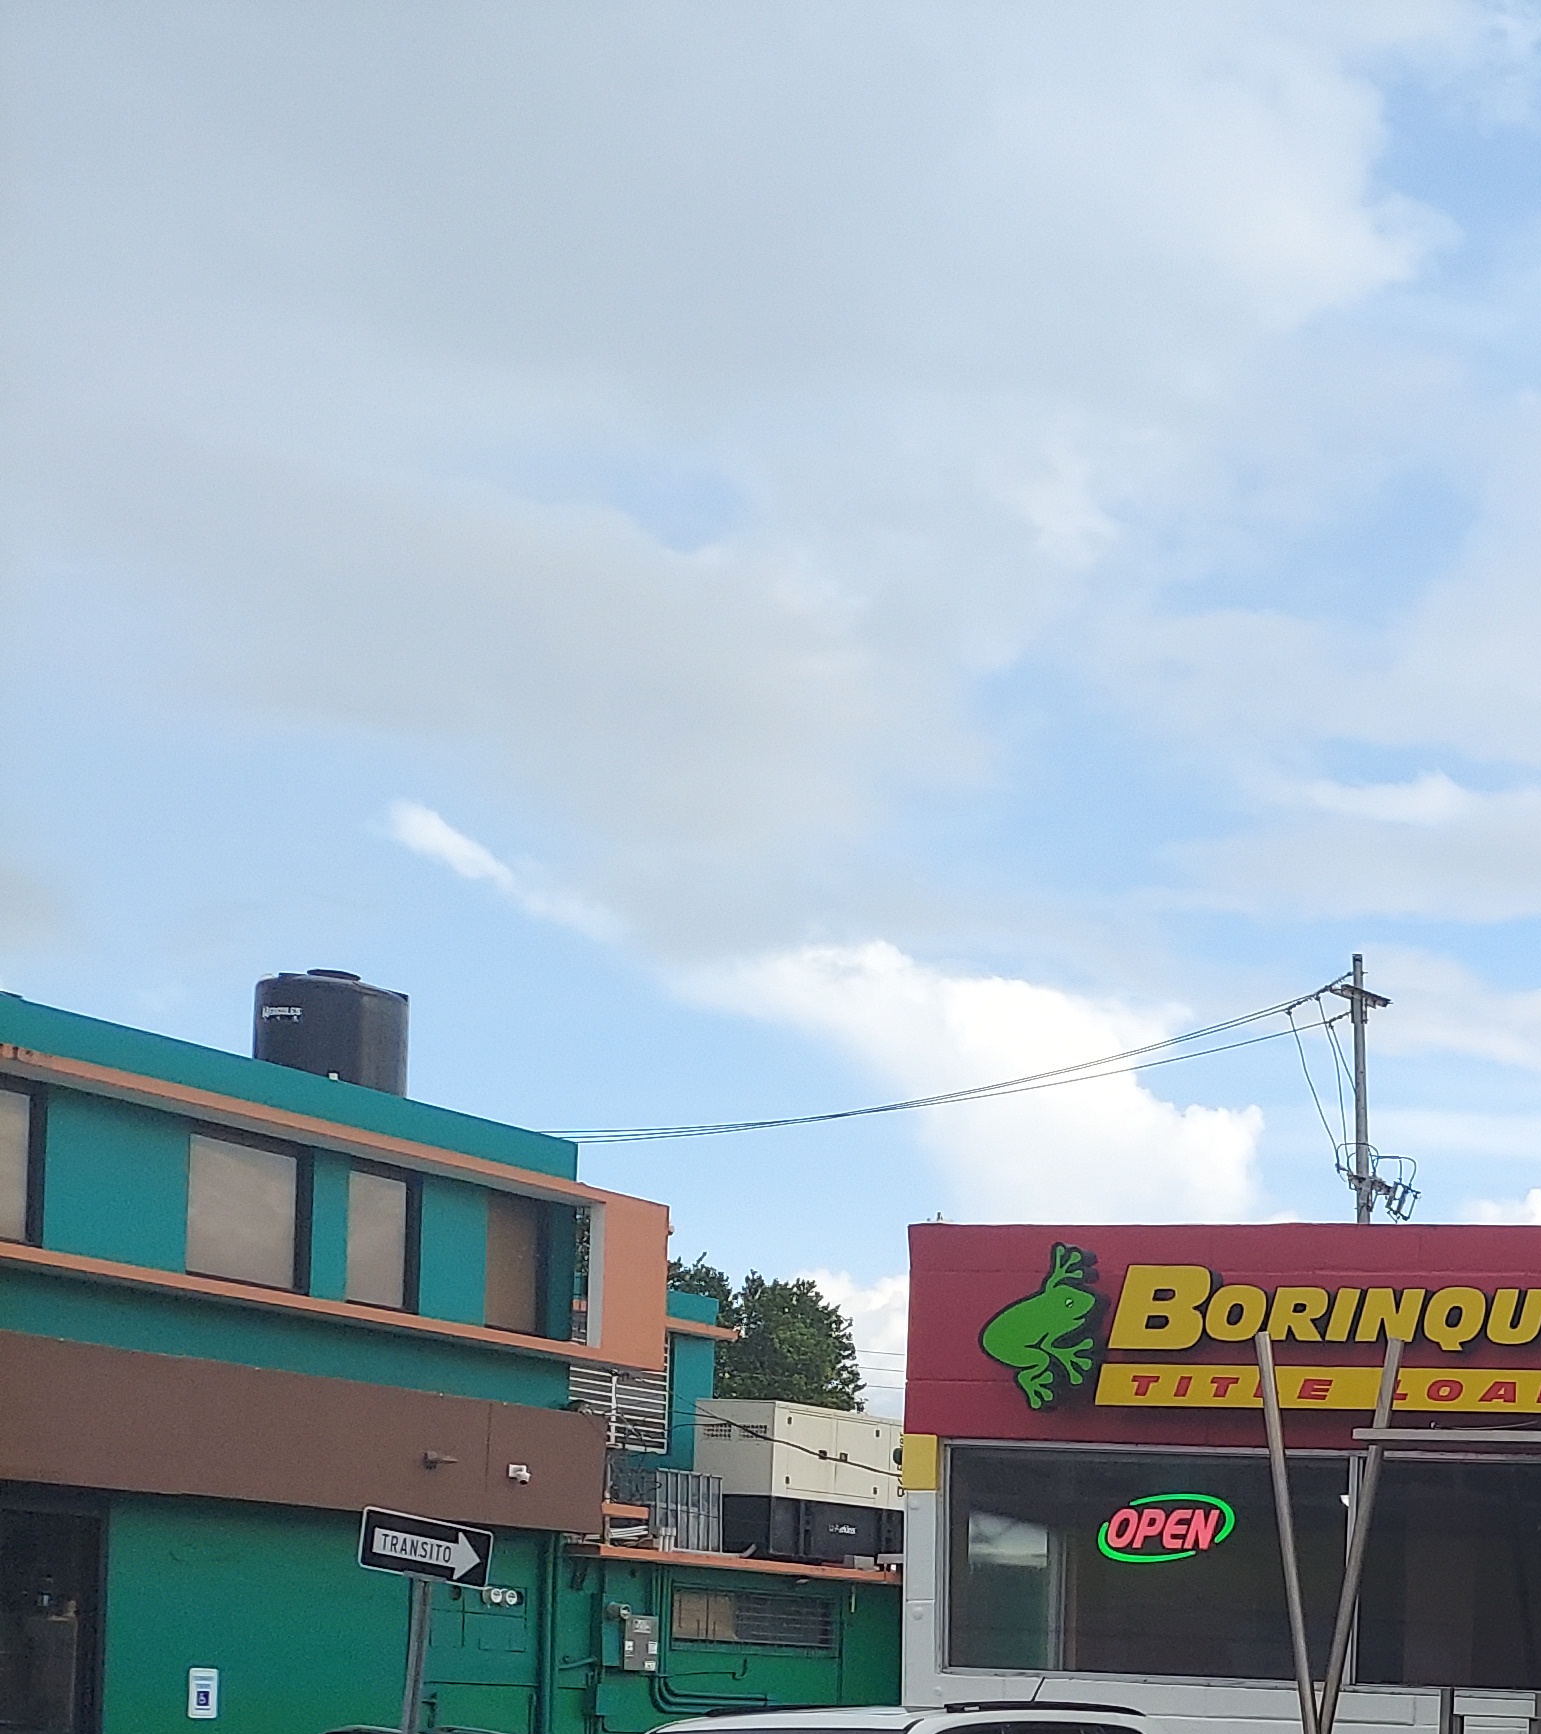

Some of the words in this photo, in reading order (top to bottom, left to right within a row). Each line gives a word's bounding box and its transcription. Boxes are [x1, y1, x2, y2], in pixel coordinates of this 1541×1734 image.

[1131, 1374, 1334, 1400] TITE
[1107, 1508, 1220, 1549] OPEN
[381, 1533, 452, 1563] TRANSITO
